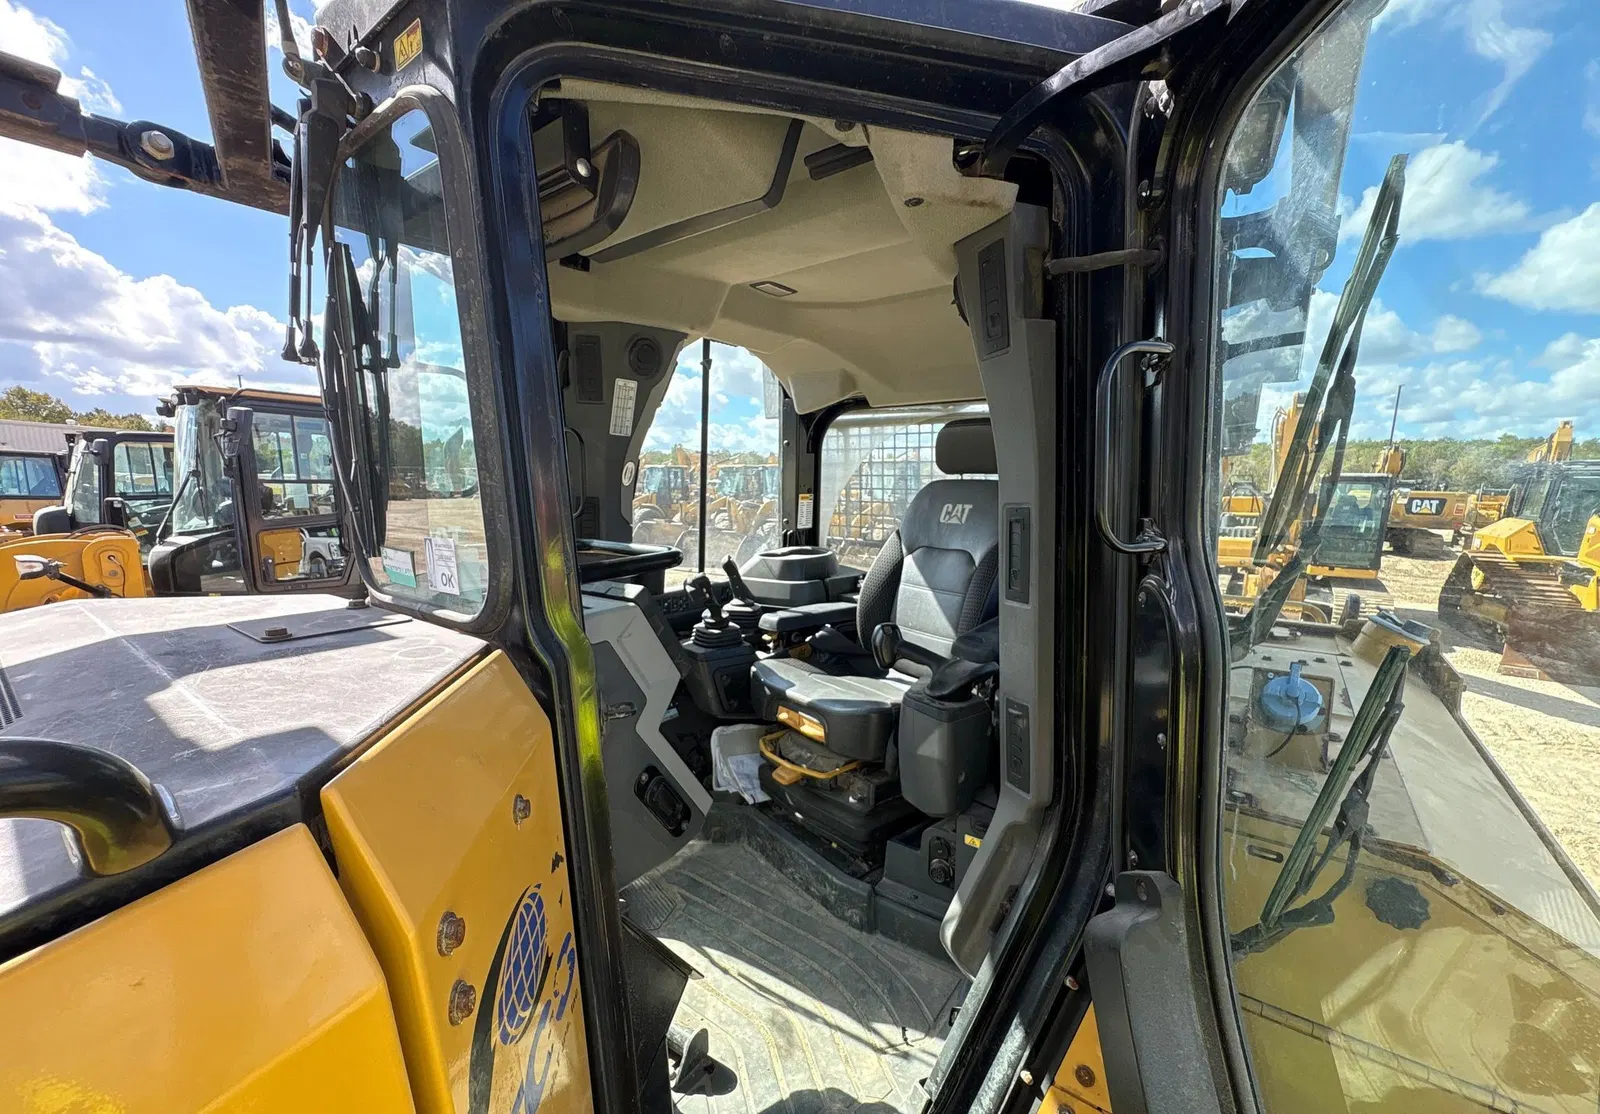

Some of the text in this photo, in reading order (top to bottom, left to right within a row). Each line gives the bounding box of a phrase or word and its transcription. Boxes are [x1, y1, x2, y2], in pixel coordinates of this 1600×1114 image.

[939, 503, 973, 524] CAT
[1411, 499, 1440, 514] CAT
[440, 572, 455, 588] OK
